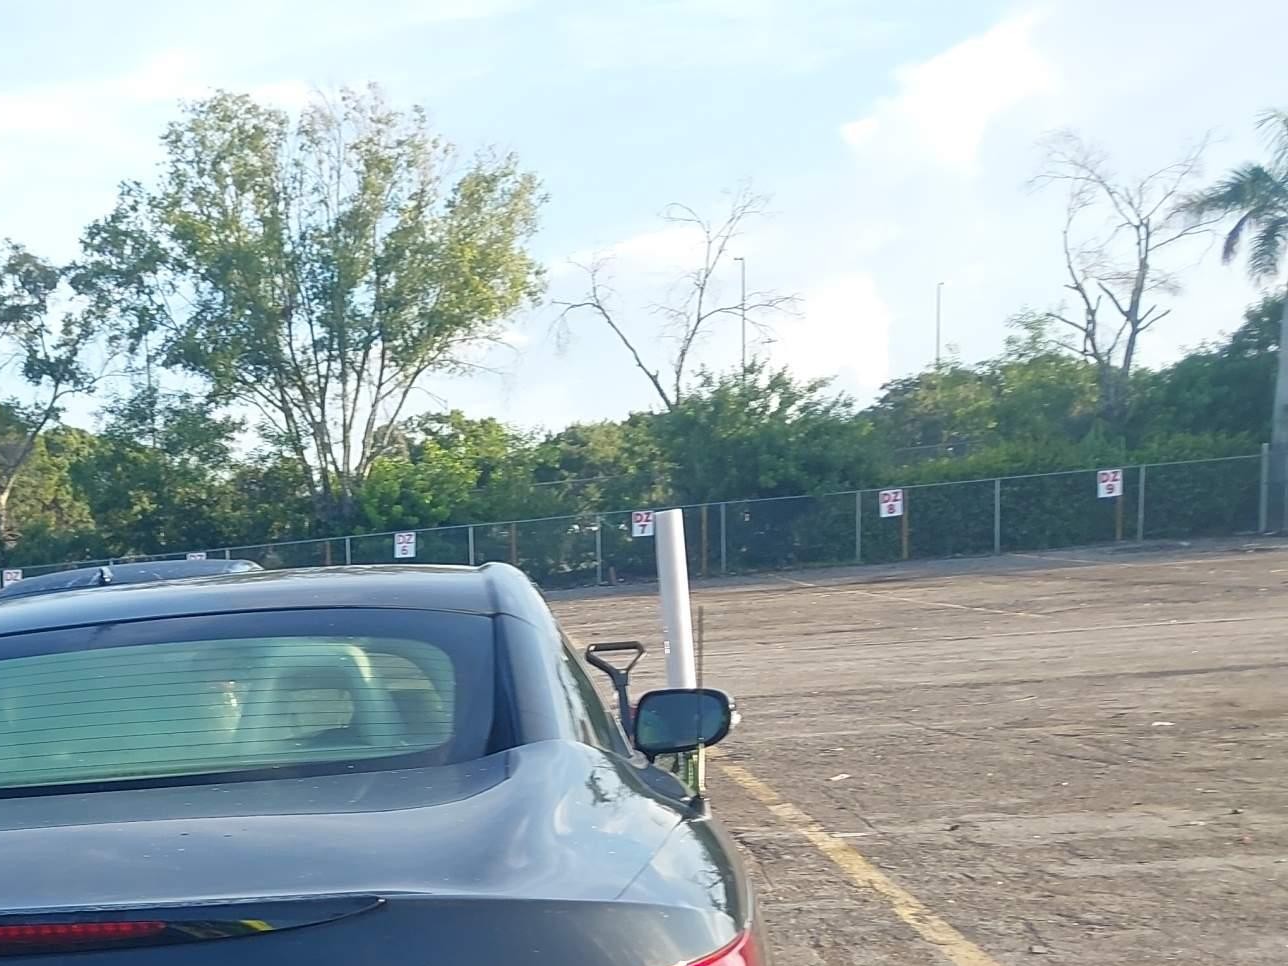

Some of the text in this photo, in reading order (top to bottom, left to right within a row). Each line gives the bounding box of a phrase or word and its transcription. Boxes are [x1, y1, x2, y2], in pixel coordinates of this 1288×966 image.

[1101, 471, 1121, 483] DZ
[1106, 484, 1114, 494] 9
[882, 491, 902, 503] DZ
[887, 504, 895, 514] 8
[634, 512, 652, 523] DZ
[639, 524, 647, 534] 7
[397, 533, 414, 544] DZ
[401, 545, 408, 555] 6
[5, 571, 20, 581] DZ
